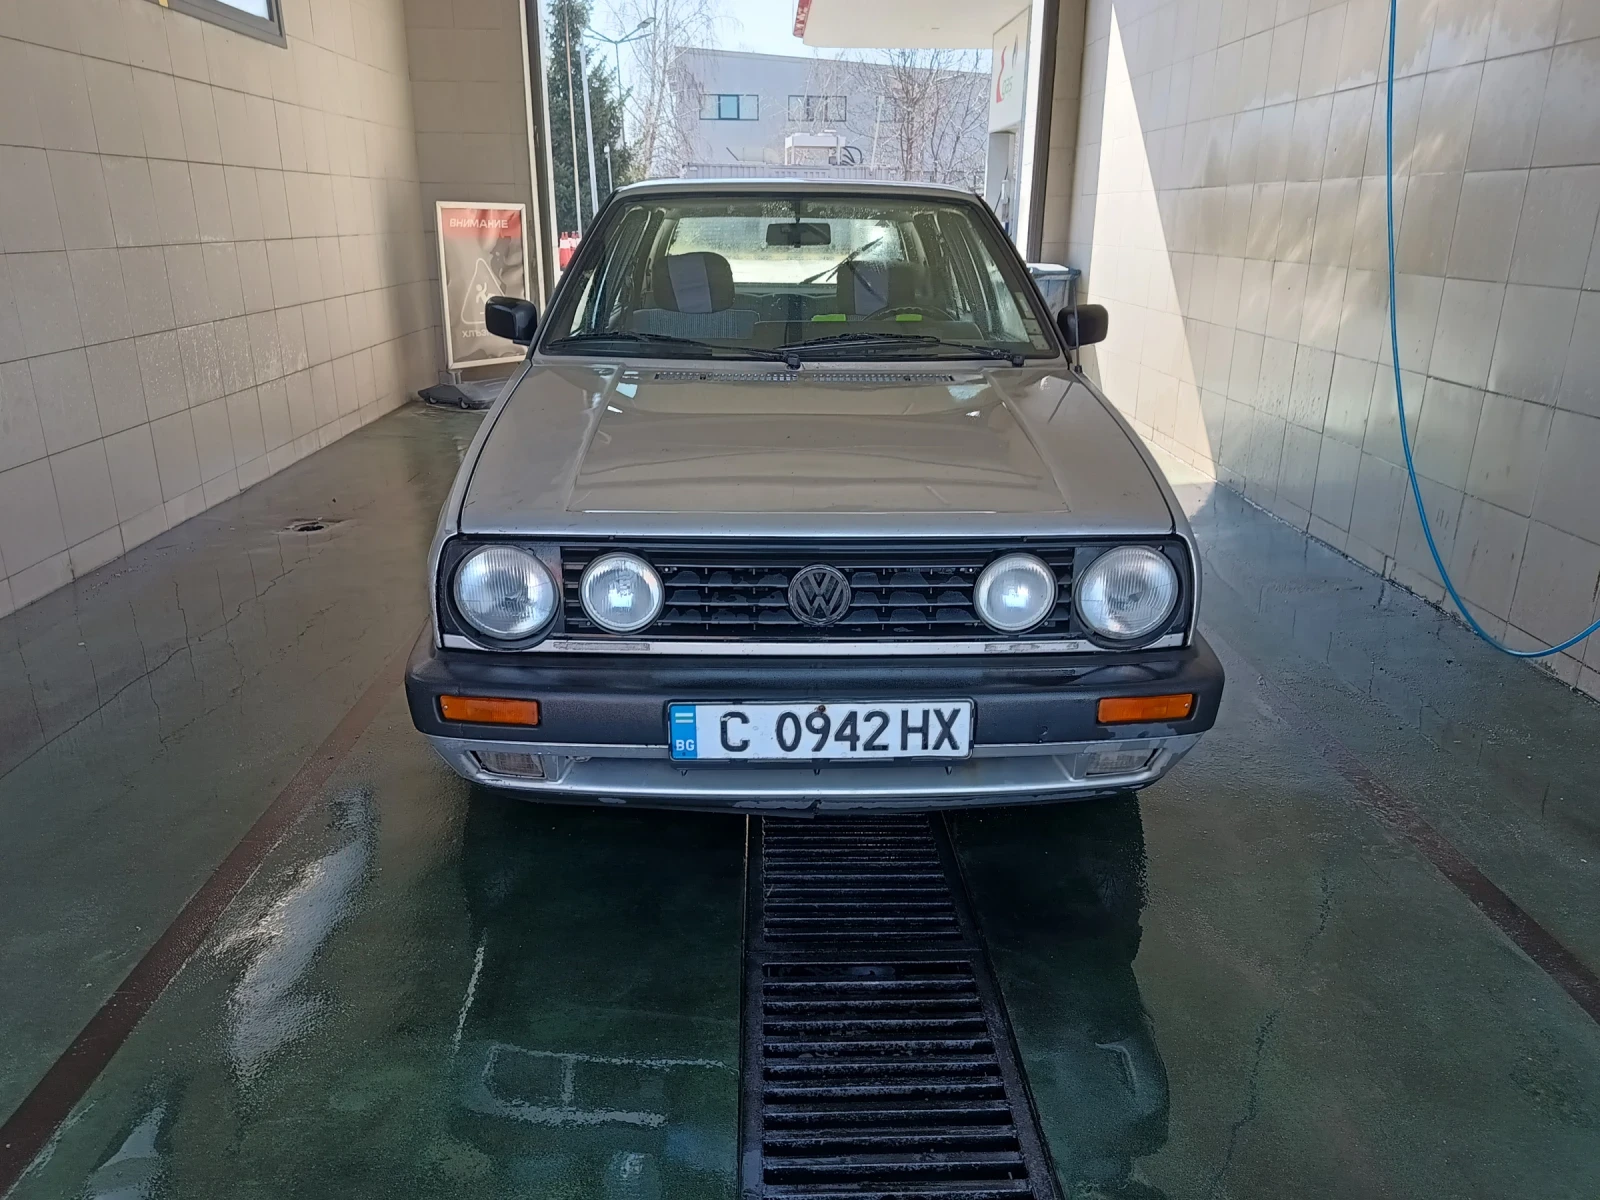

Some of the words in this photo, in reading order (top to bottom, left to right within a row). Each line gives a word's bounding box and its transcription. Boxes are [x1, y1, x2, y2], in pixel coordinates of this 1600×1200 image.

[449, 218, 509, 229] ВНИМАНИЕ
[793, 569, 846, 620] VW
[675, 739, 695, 751] BG
